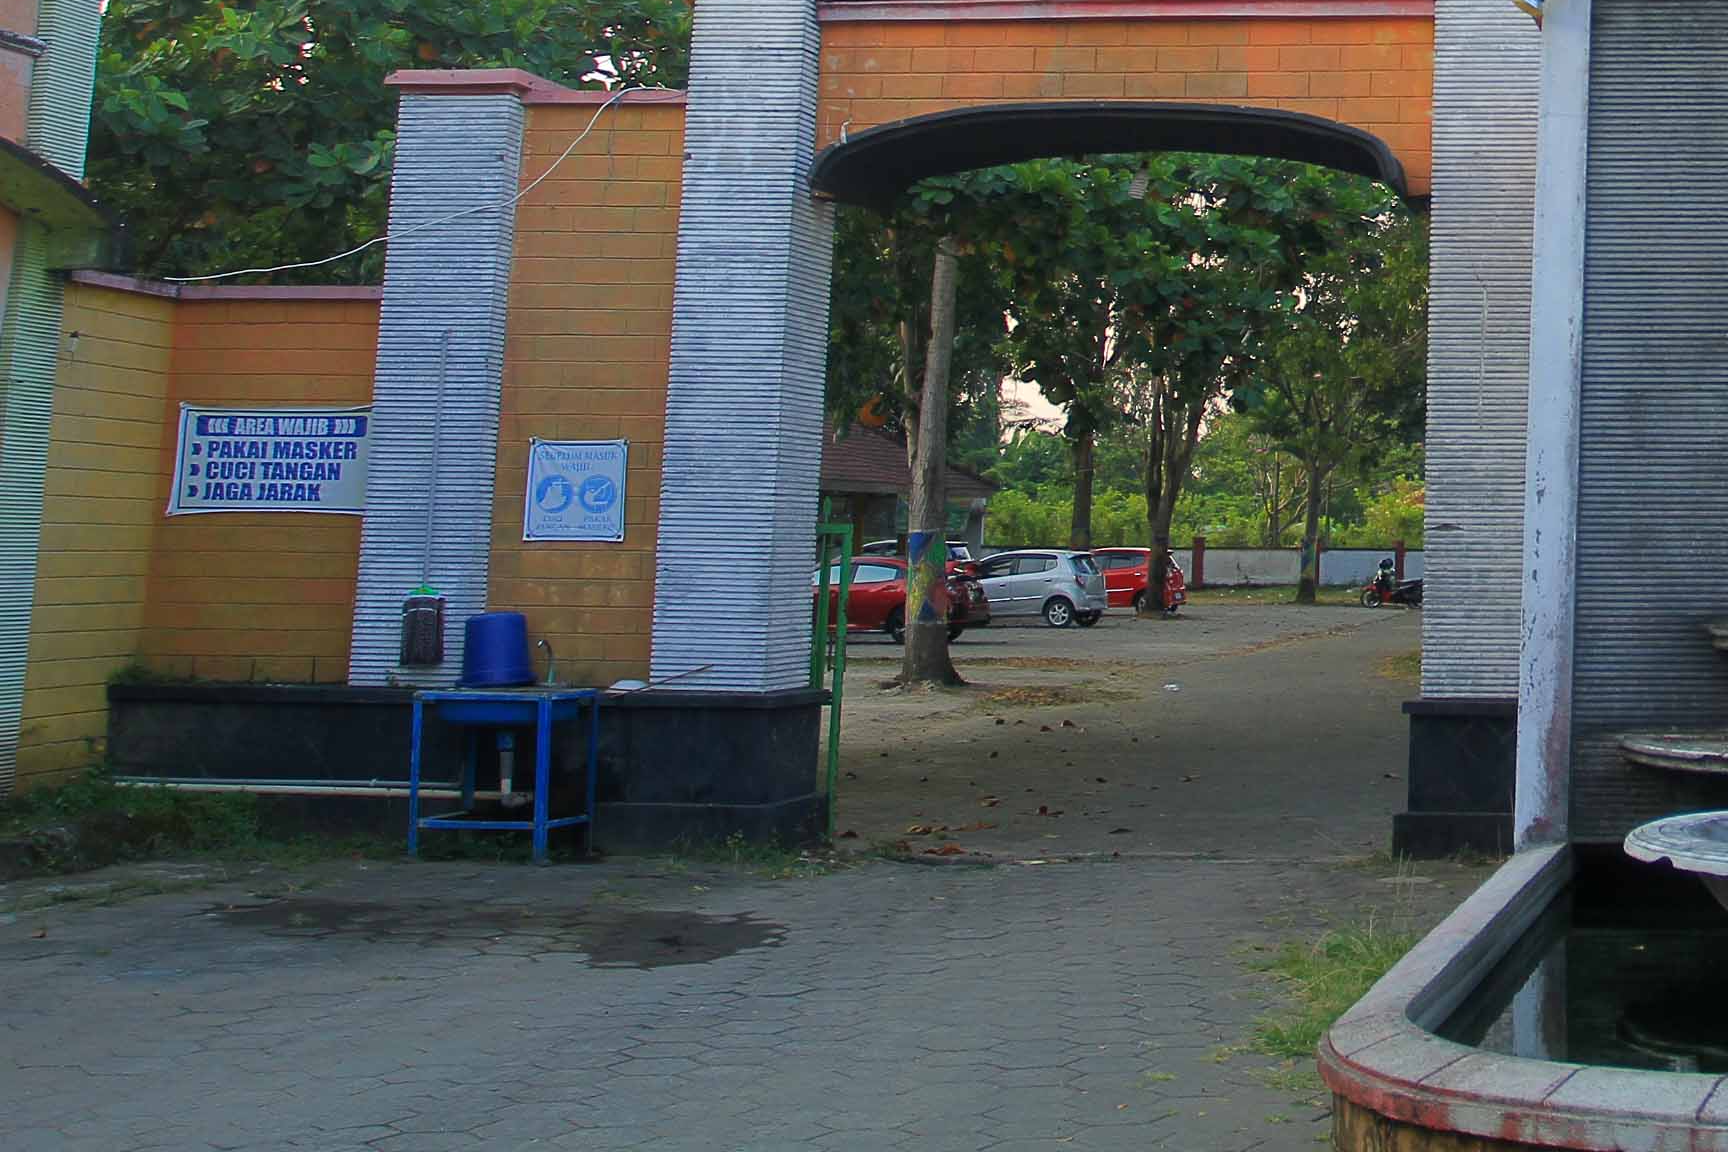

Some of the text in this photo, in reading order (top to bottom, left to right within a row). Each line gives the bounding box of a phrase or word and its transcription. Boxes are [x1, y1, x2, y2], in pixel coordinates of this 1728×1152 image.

[235, 417, 330, 435] AREA WAJIB
[207, 440, 358, 460] PAKAI MASKER
[205, 461, 342, 481] CUCI TANGAN
[202, 482, 321, 502] JAGA JARAK
